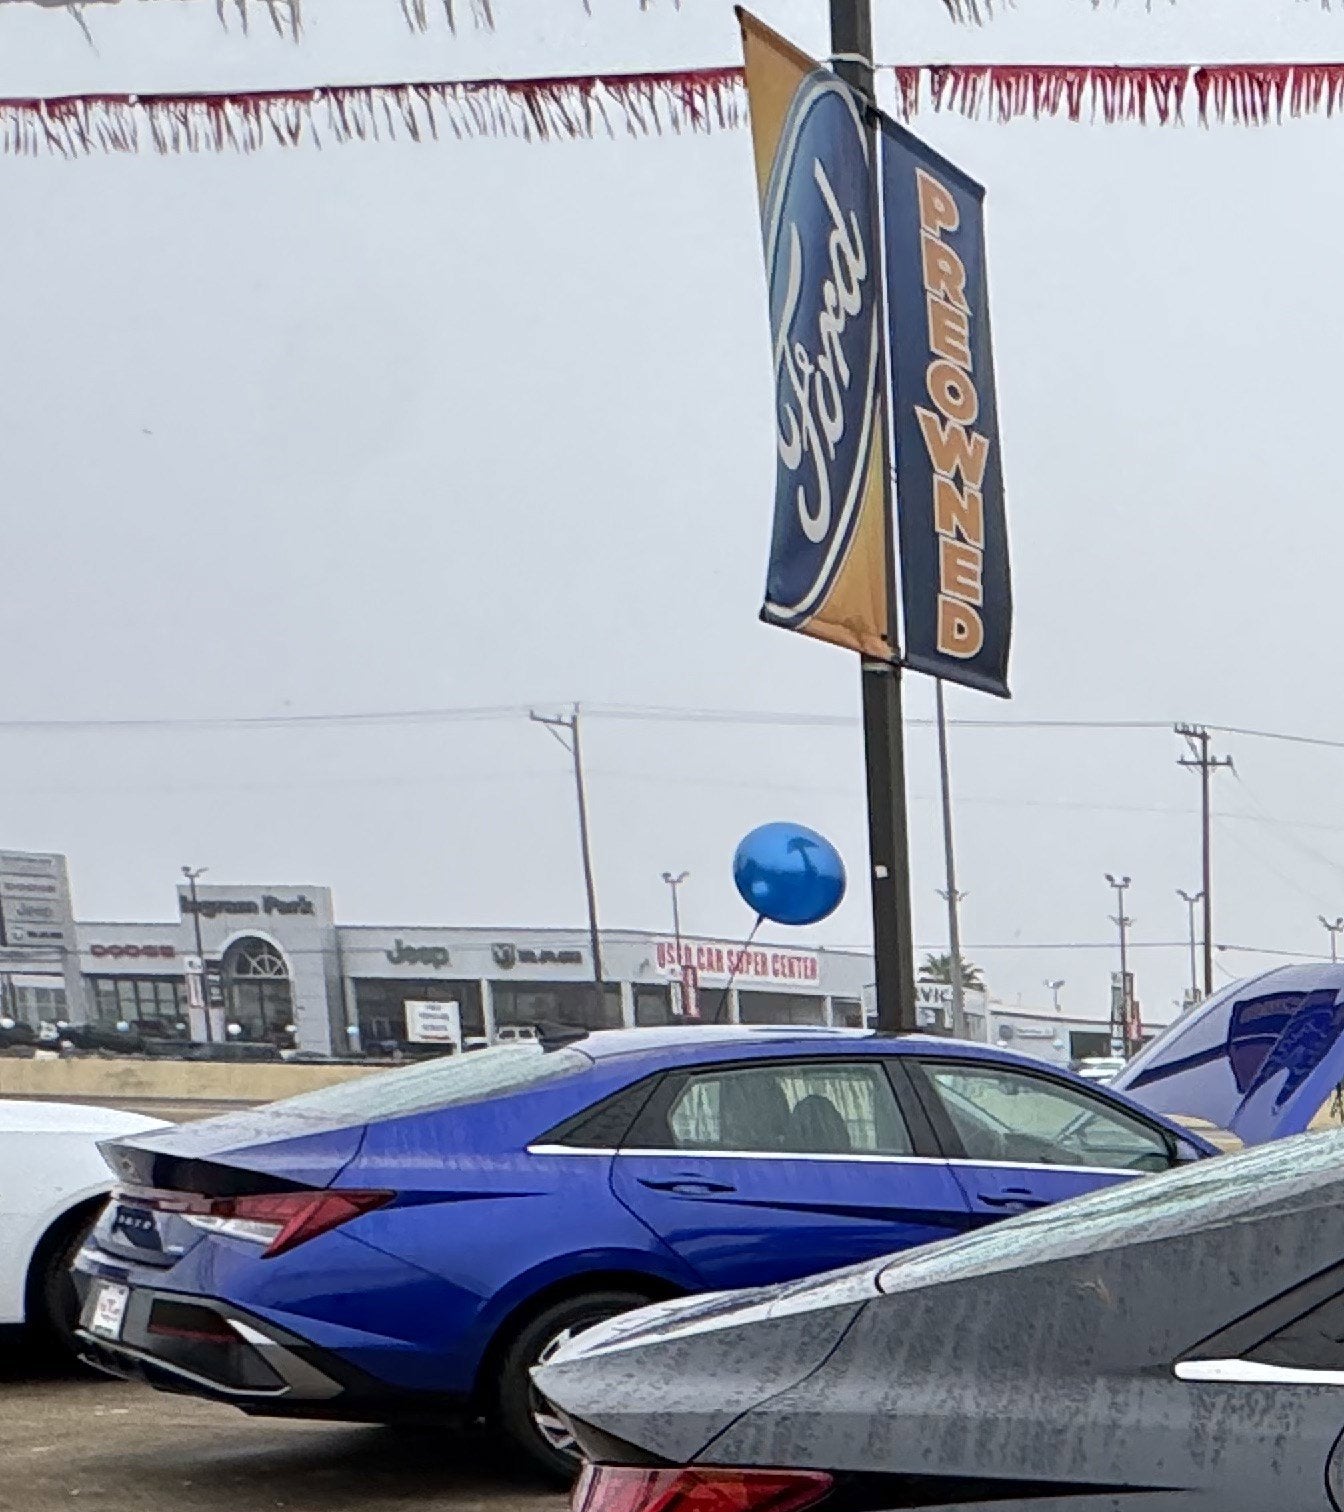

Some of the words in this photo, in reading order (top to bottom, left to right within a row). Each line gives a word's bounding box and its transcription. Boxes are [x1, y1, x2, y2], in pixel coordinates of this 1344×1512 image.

[776, 157, 869, 546] Ford
[915, 167, 989, 660] PREOWNED
[261, 894, 315, 915] Park
[90, 944, 175, 957] DODGE
[386, 938, 450, 969] Jeep
[518, 949, 583, 964] RAM
[696, 946, 725, 974] CAR
[771, 952, 818, 980] CENTER
